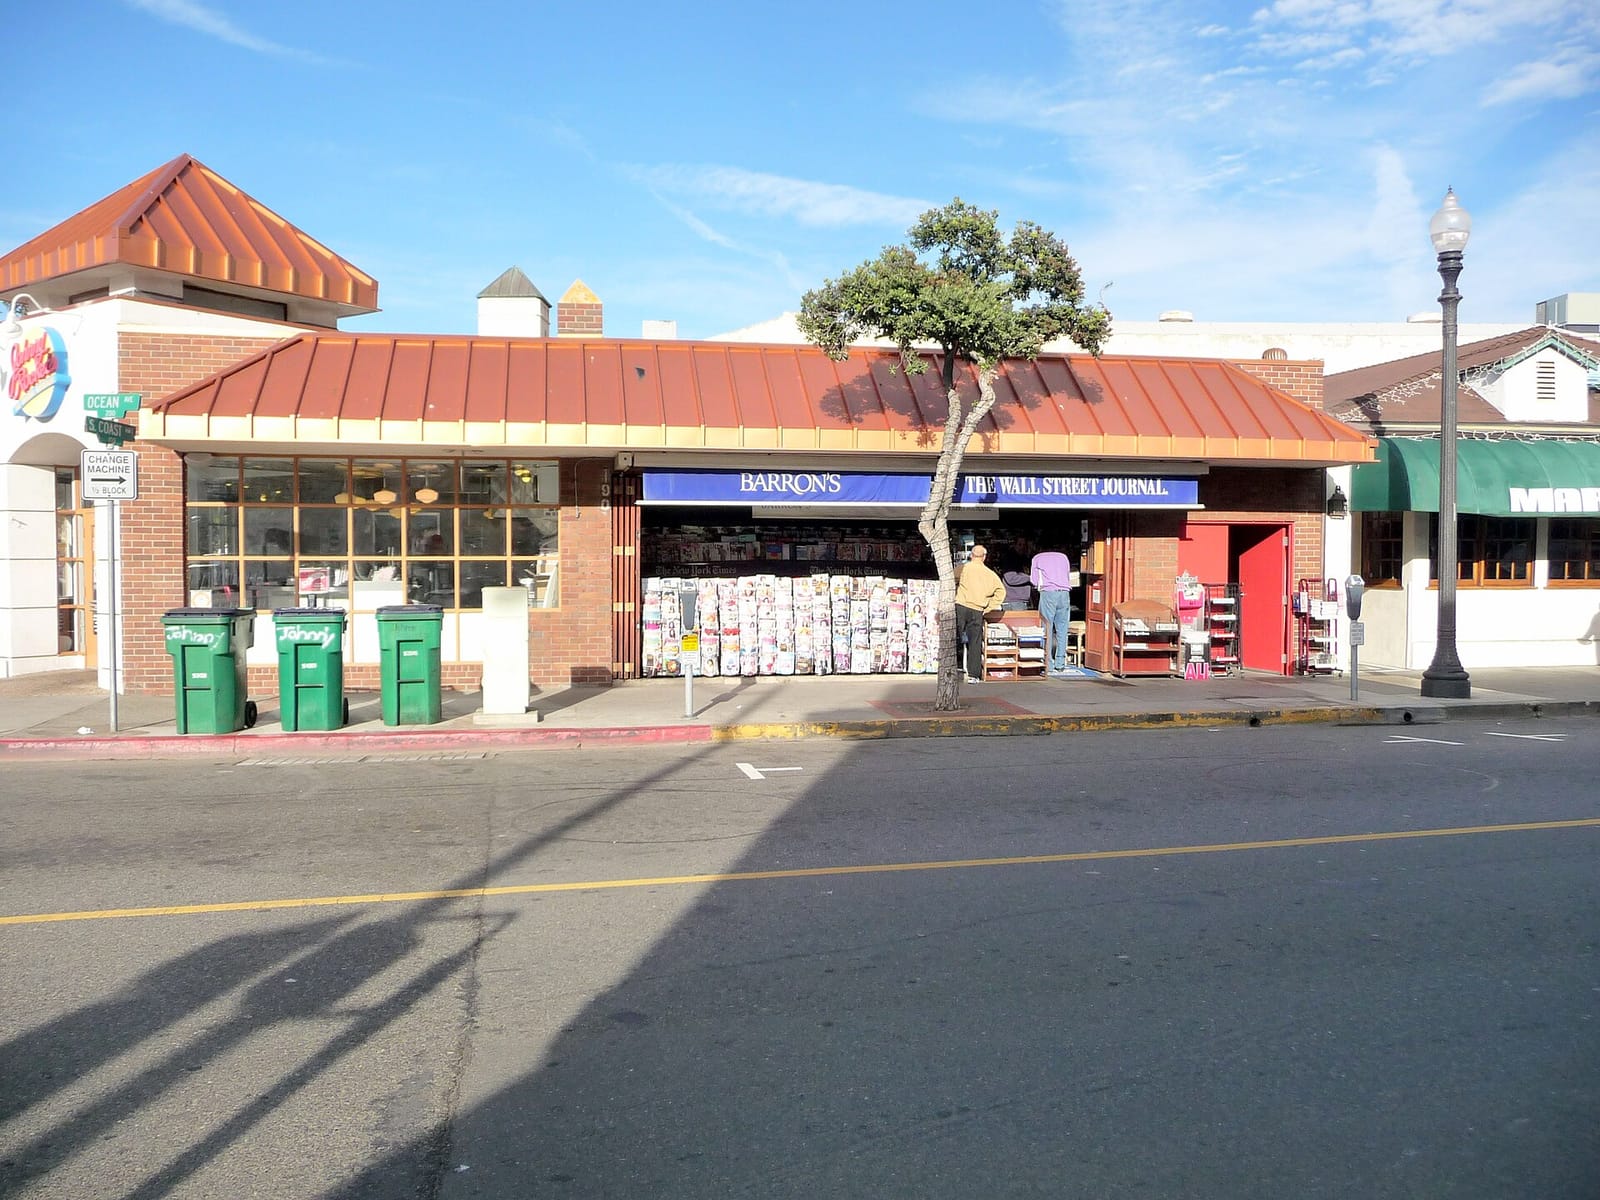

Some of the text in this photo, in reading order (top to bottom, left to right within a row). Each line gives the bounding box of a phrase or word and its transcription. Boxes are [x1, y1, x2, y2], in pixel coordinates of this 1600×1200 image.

[87, 396, 119, 409] OCEAN
[98, 420, 122, 437] COAST
[88, 455, 129, 464] CHANGE
[87, 465, 131, 473] MACHINE
[740, 472, 841, 495] BARRON'S
[965, 476, 996, 494] THE
[1000, 476, 1040, 495] WALL
[1042, 477, 1099, 496] STREET
[656, 565, 737, 576] The New York Times
[843, 566, 864, 575] York
[864, 566, 888, 575] Times
[276, 624, 335, 649] Johnny
